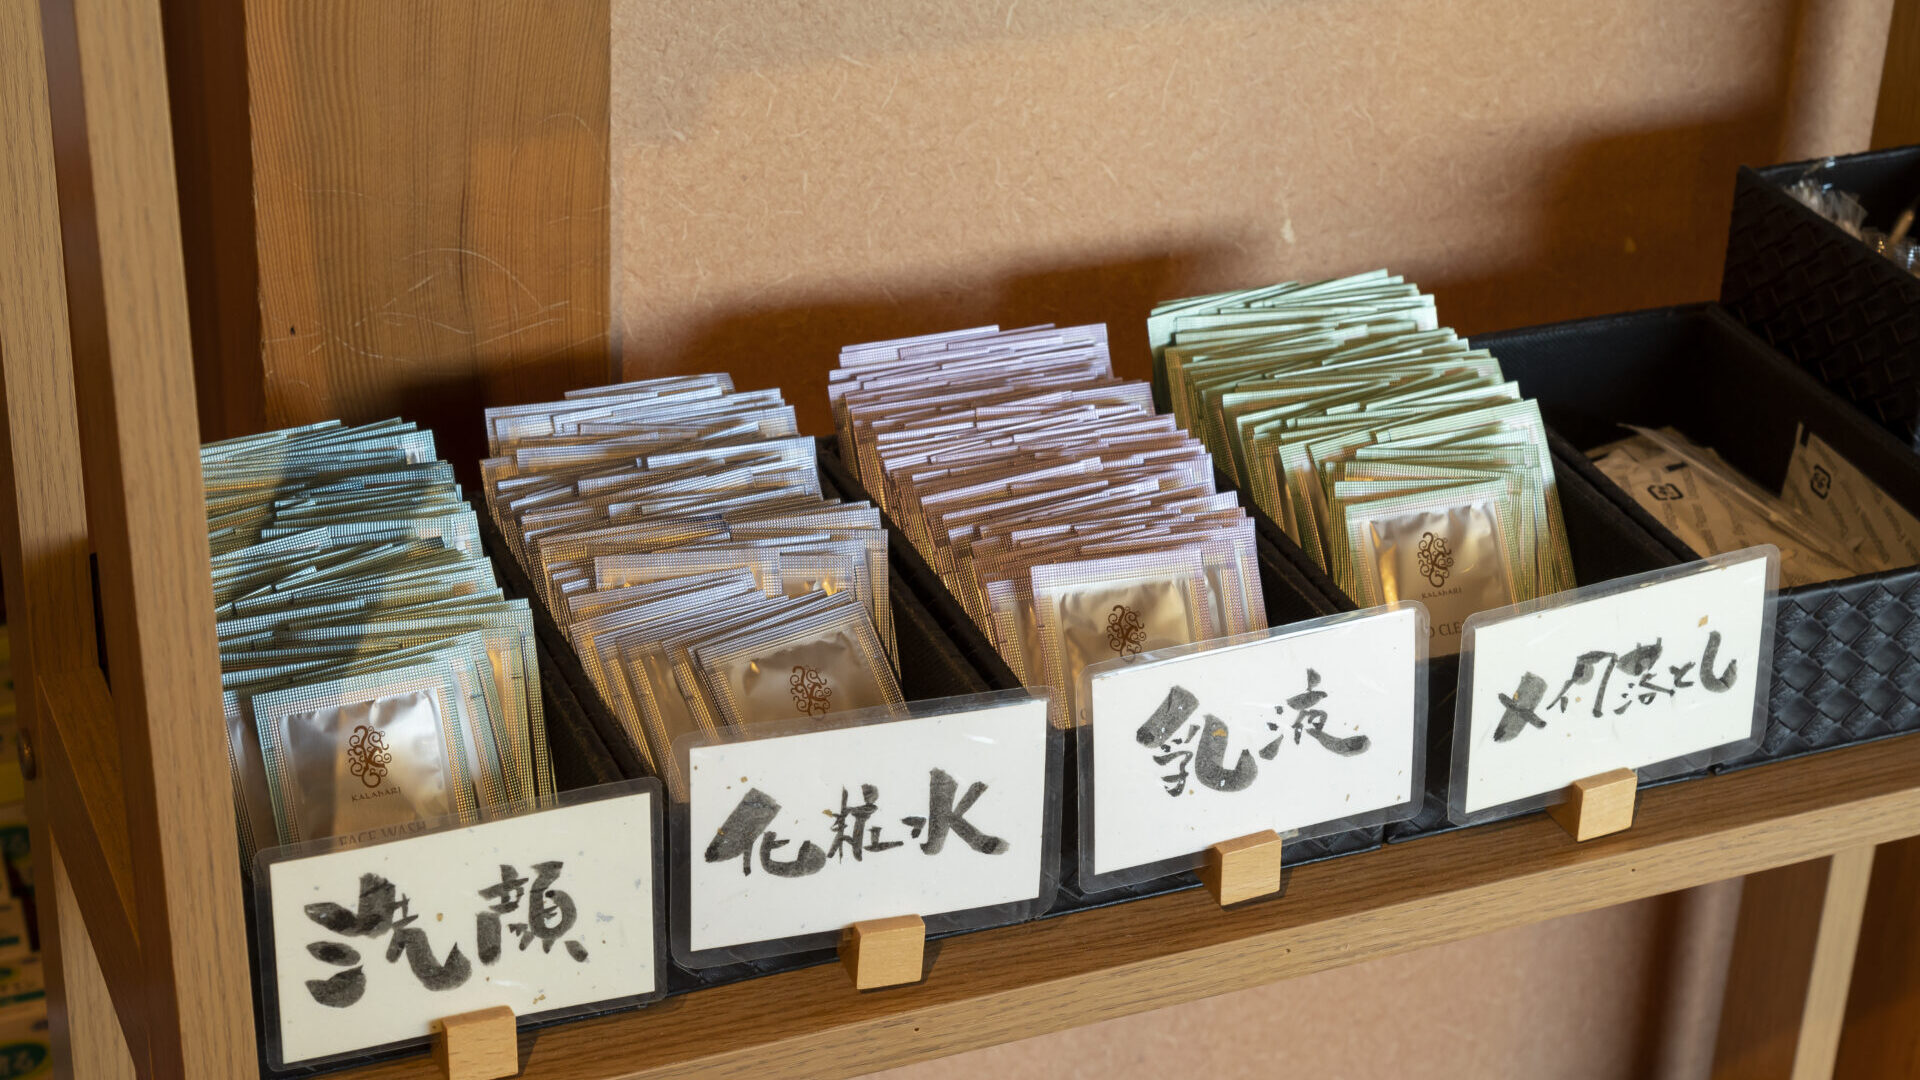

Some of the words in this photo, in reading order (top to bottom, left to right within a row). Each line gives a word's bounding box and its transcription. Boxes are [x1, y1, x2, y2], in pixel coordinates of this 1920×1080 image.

[1136, 668, 1372, 797] 乳液
[339, 830, 377, 846] FACE
[381, 821, 427, 838] WASH
[704, 767, 1010, 878] 化粧水
[304, 861, 588, 1008] 洗顔
